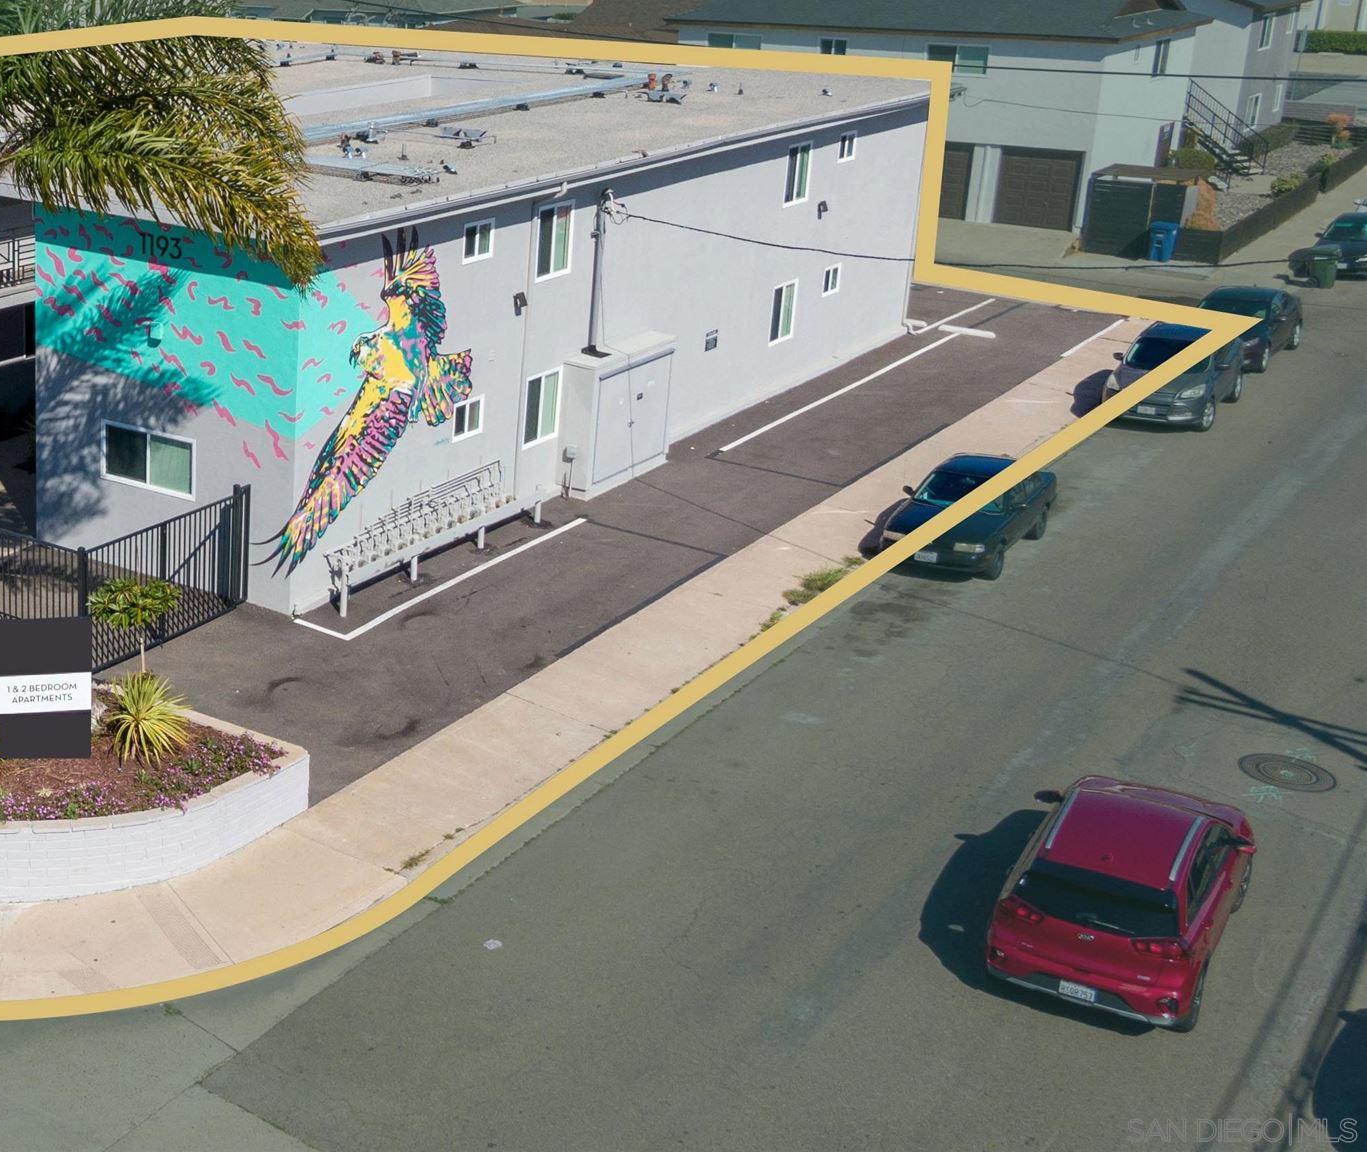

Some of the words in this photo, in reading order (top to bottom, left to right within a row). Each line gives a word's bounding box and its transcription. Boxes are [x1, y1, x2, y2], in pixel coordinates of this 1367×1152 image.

[139, 232, 182, 259] 1193
[12, 685, 20, 693] &
[21, 685, 27, 693] 2
[29, 683, 77, 693] BEDROOM
[12, 693, 73, 703] APARTMENTS
